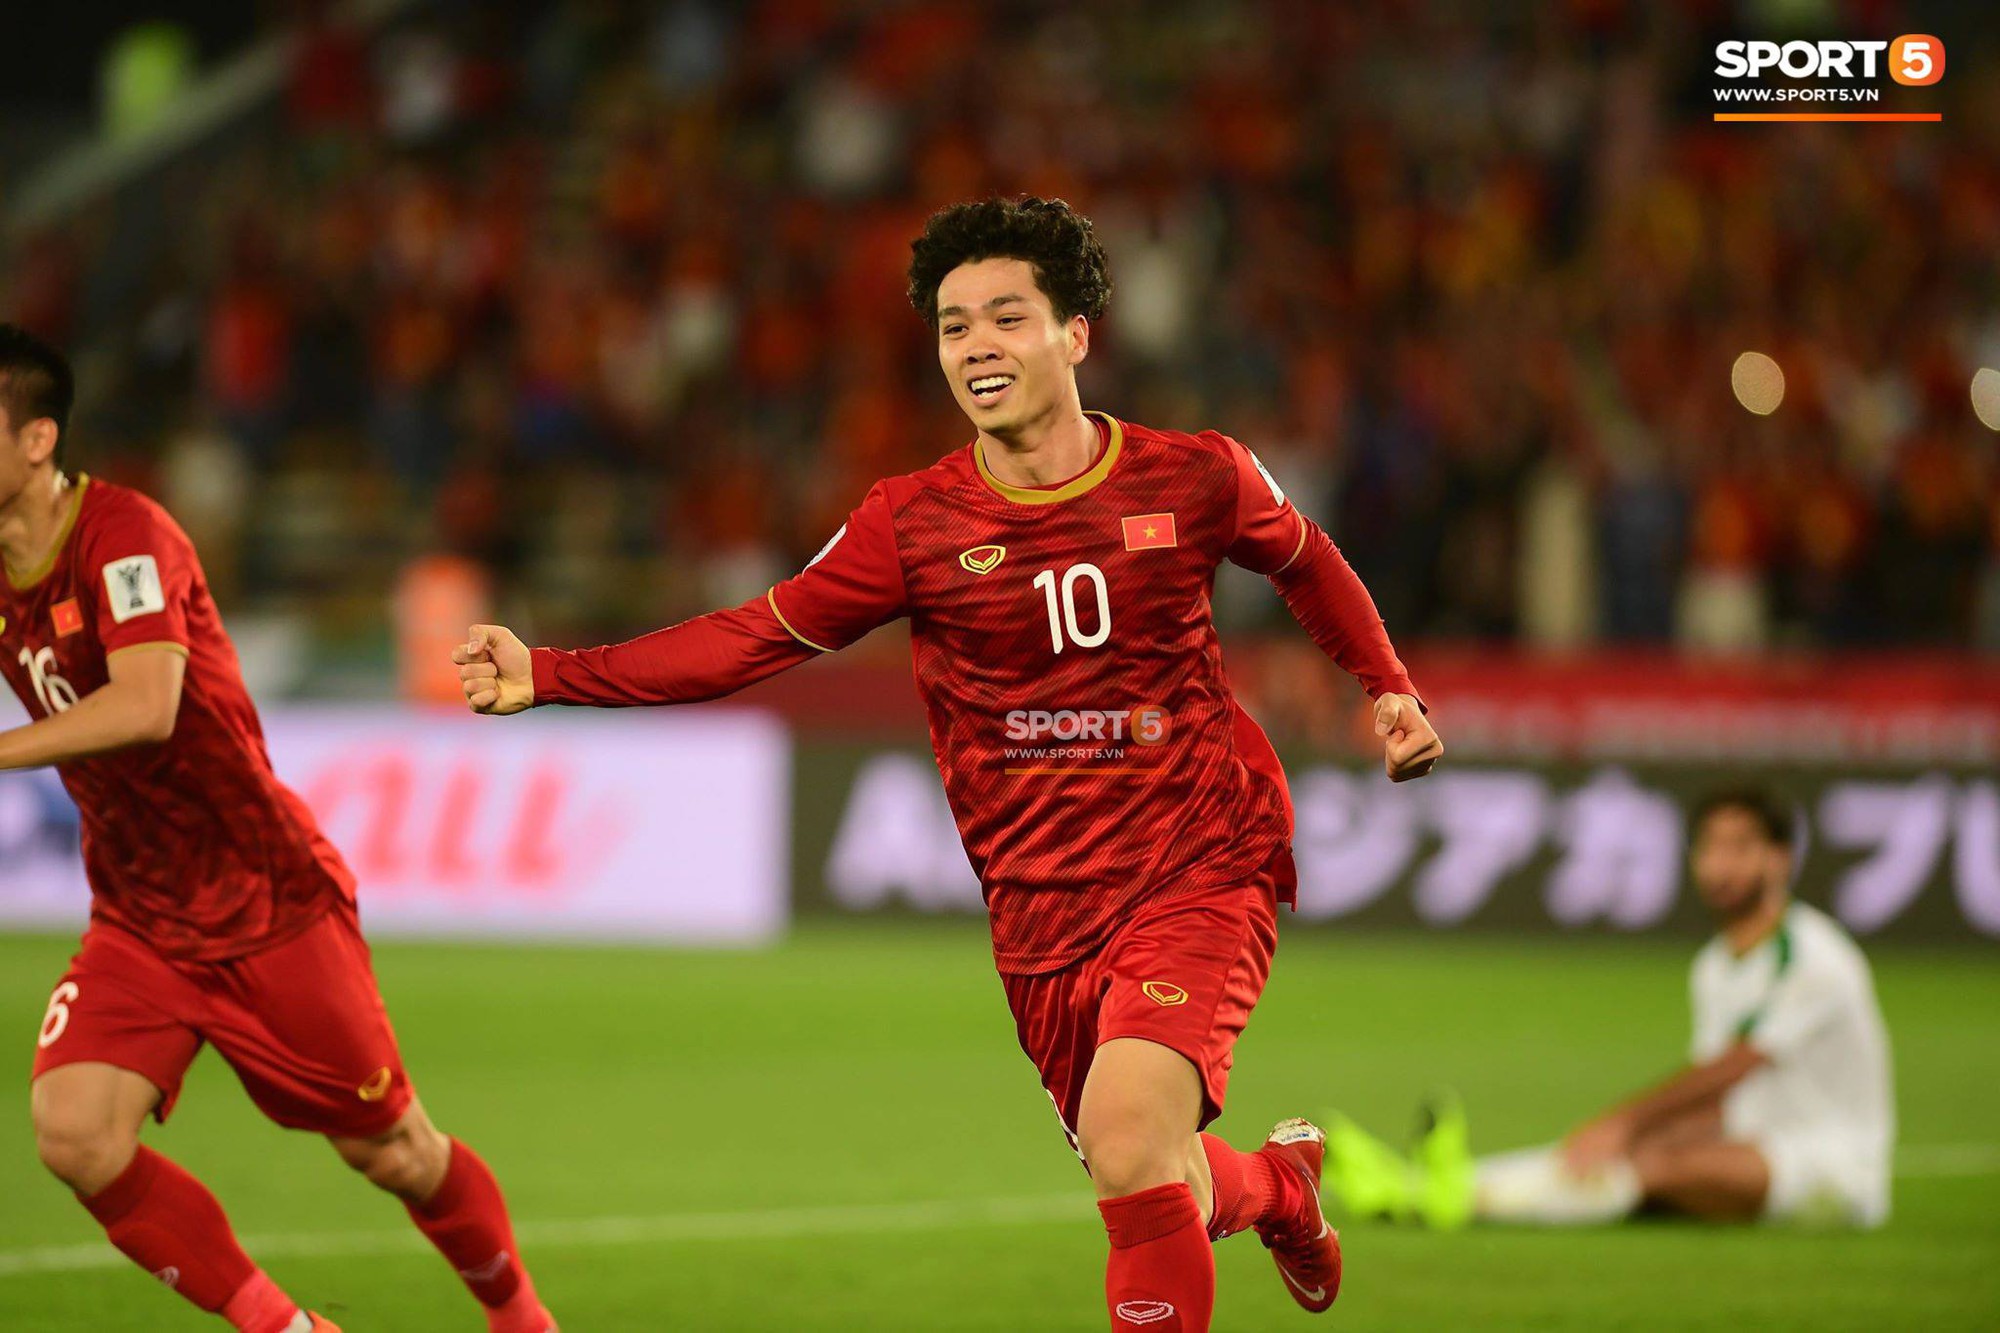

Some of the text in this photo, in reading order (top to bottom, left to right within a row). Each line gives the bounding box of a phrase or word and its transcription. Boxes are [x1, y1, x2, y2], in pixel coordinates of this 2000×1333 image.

[1032, 562, 1112, 655] 10
[17, 645, 81, 719] 16
[38, 981, 80, 1049] 6
